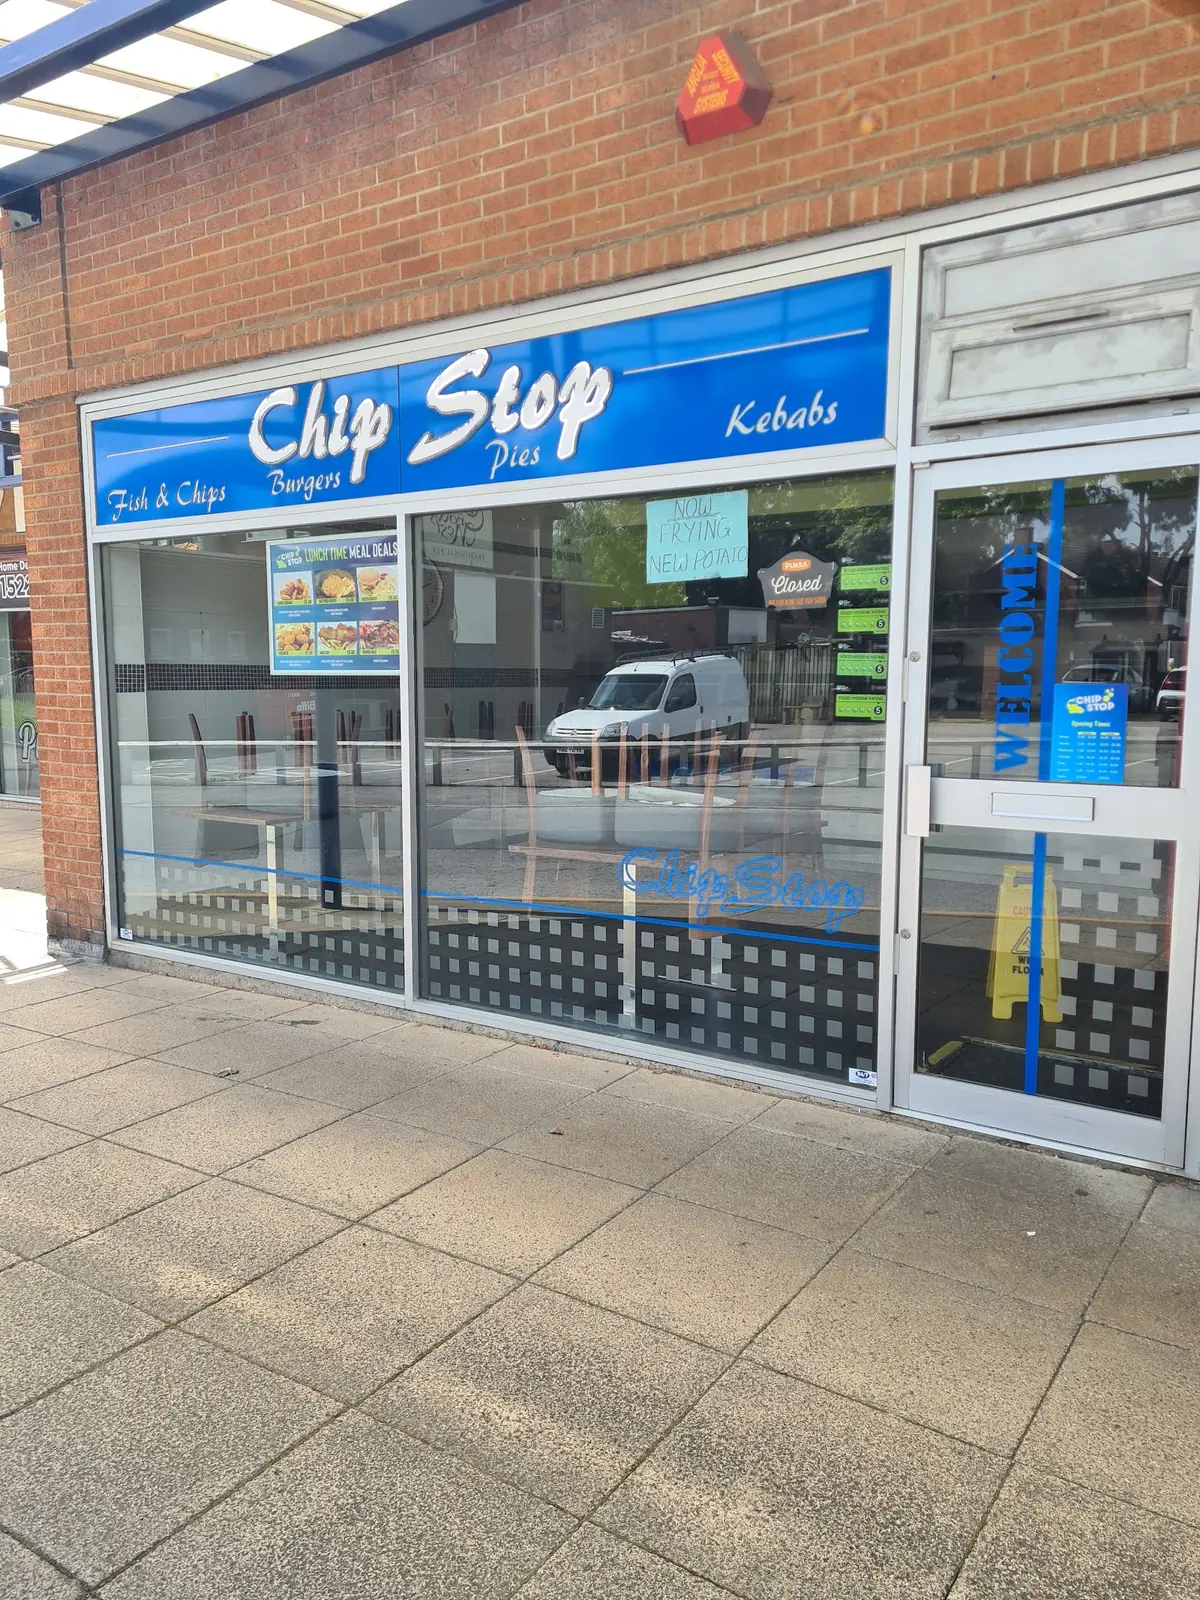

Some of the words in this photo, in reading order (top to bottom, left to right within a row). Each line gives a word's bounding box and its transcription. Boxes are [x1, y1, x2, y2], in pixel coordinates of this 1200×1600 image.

[248, 379, 393, 485] Chip
[407, 347, 614, 465] Stop
[725, 390, 838, 438] Kebabs
[485, 439, 540, 480] Pies
[266, 469, 341, 500] Burgers
[107, 489, 148, 521] Fish
[156, 482, 168, 509] &
[176, 480, 226, 512] Chips
[673, 498, 713, 519] NOW
[659, 517, 731, 544] FRYING
[281, 551, 295, 561] CHIP
[288, 556, 303, 566] STOP
[304, 548, 328, 562] LUNCH
[330, 546, 348, 561] TIME
[349, 543, 371, 559] MEAL
[372, 541, 398, 557] DEALS
[650, 553, 689, 576] NEW
[771, 575, 823, 595] Closed
[993, 543, 1038, 772] WELCOME
[1075, 695, 1102, 704] CHIP
[1087, 702, 1115, 712] STOP
[617, 847, 730, 918] Chip
[719, 856, 864, 934] Stop
